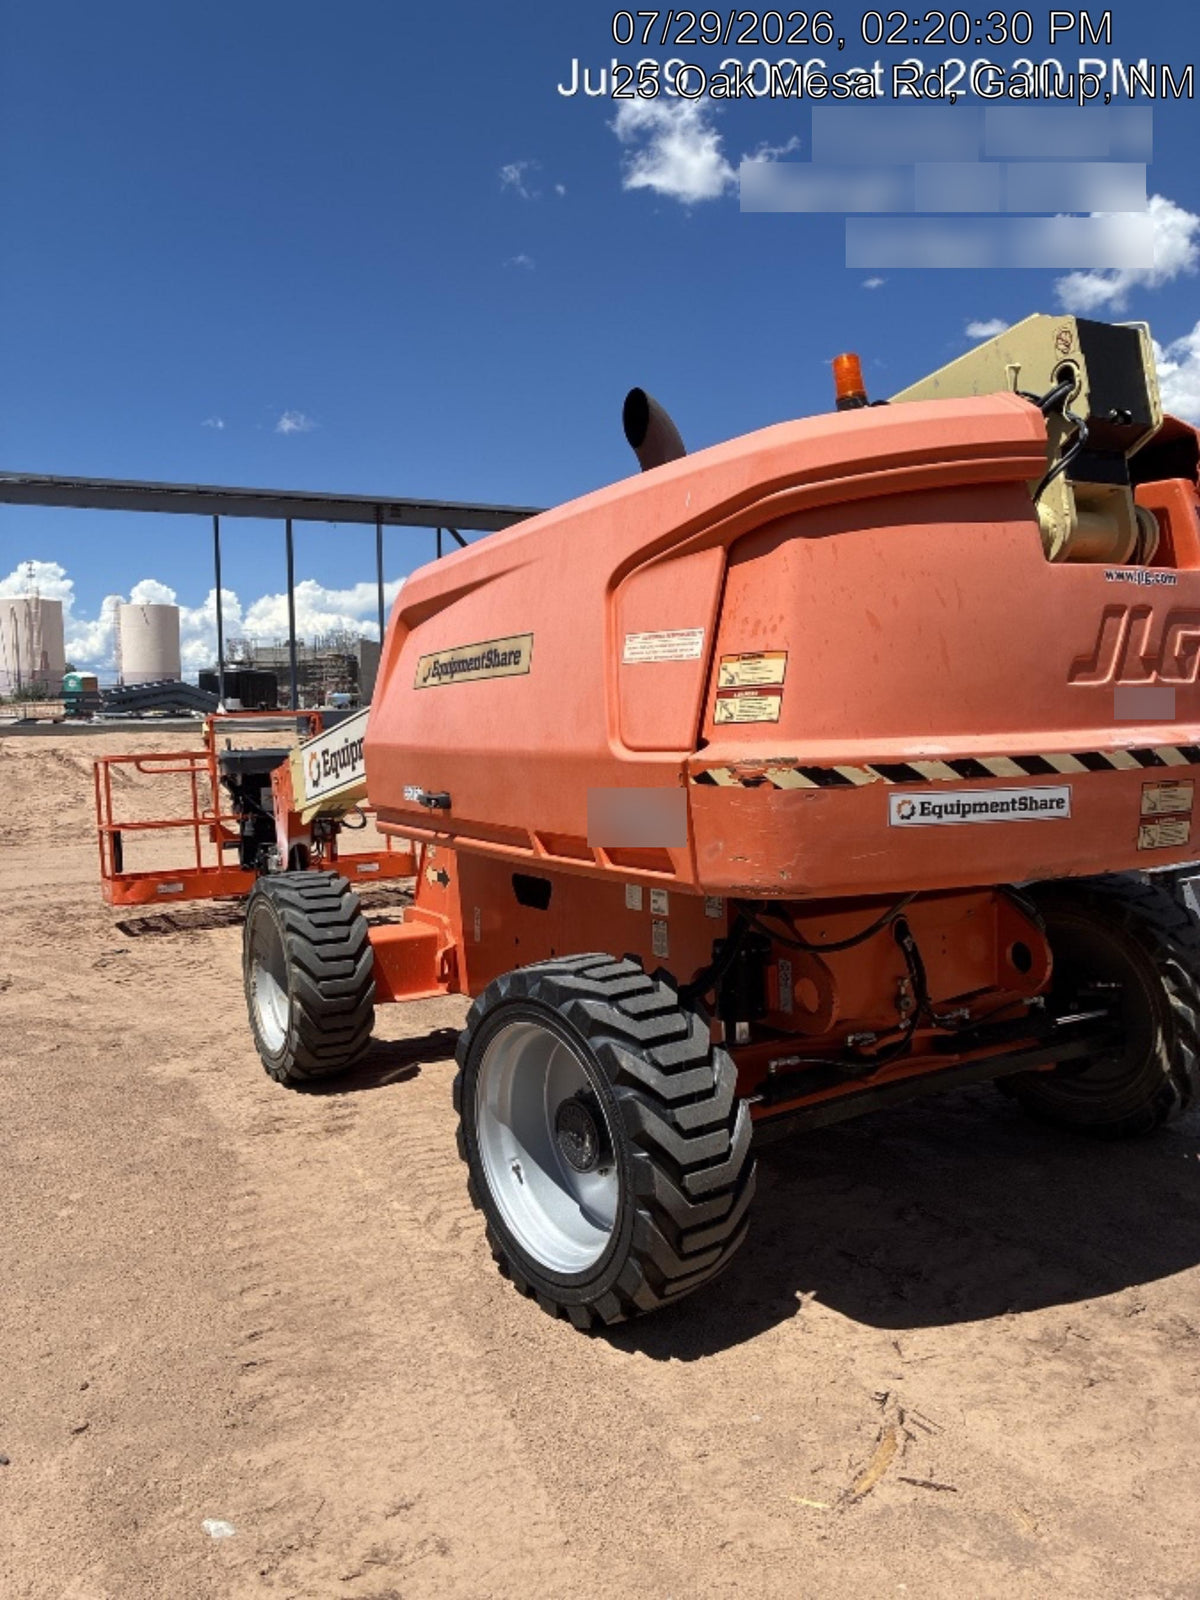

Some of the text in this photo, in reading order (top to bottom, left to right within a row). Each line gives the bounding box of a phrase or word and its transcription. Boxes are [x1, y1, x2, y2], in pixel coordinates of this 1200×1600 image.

[1105, 570, 1177, 586] www.jlg.com
[1067, 603, 1200, 685] JLG
[431, 648, 522, 680] EquipmentShare
[918, 795, 1066, 818] EquipmentShare
